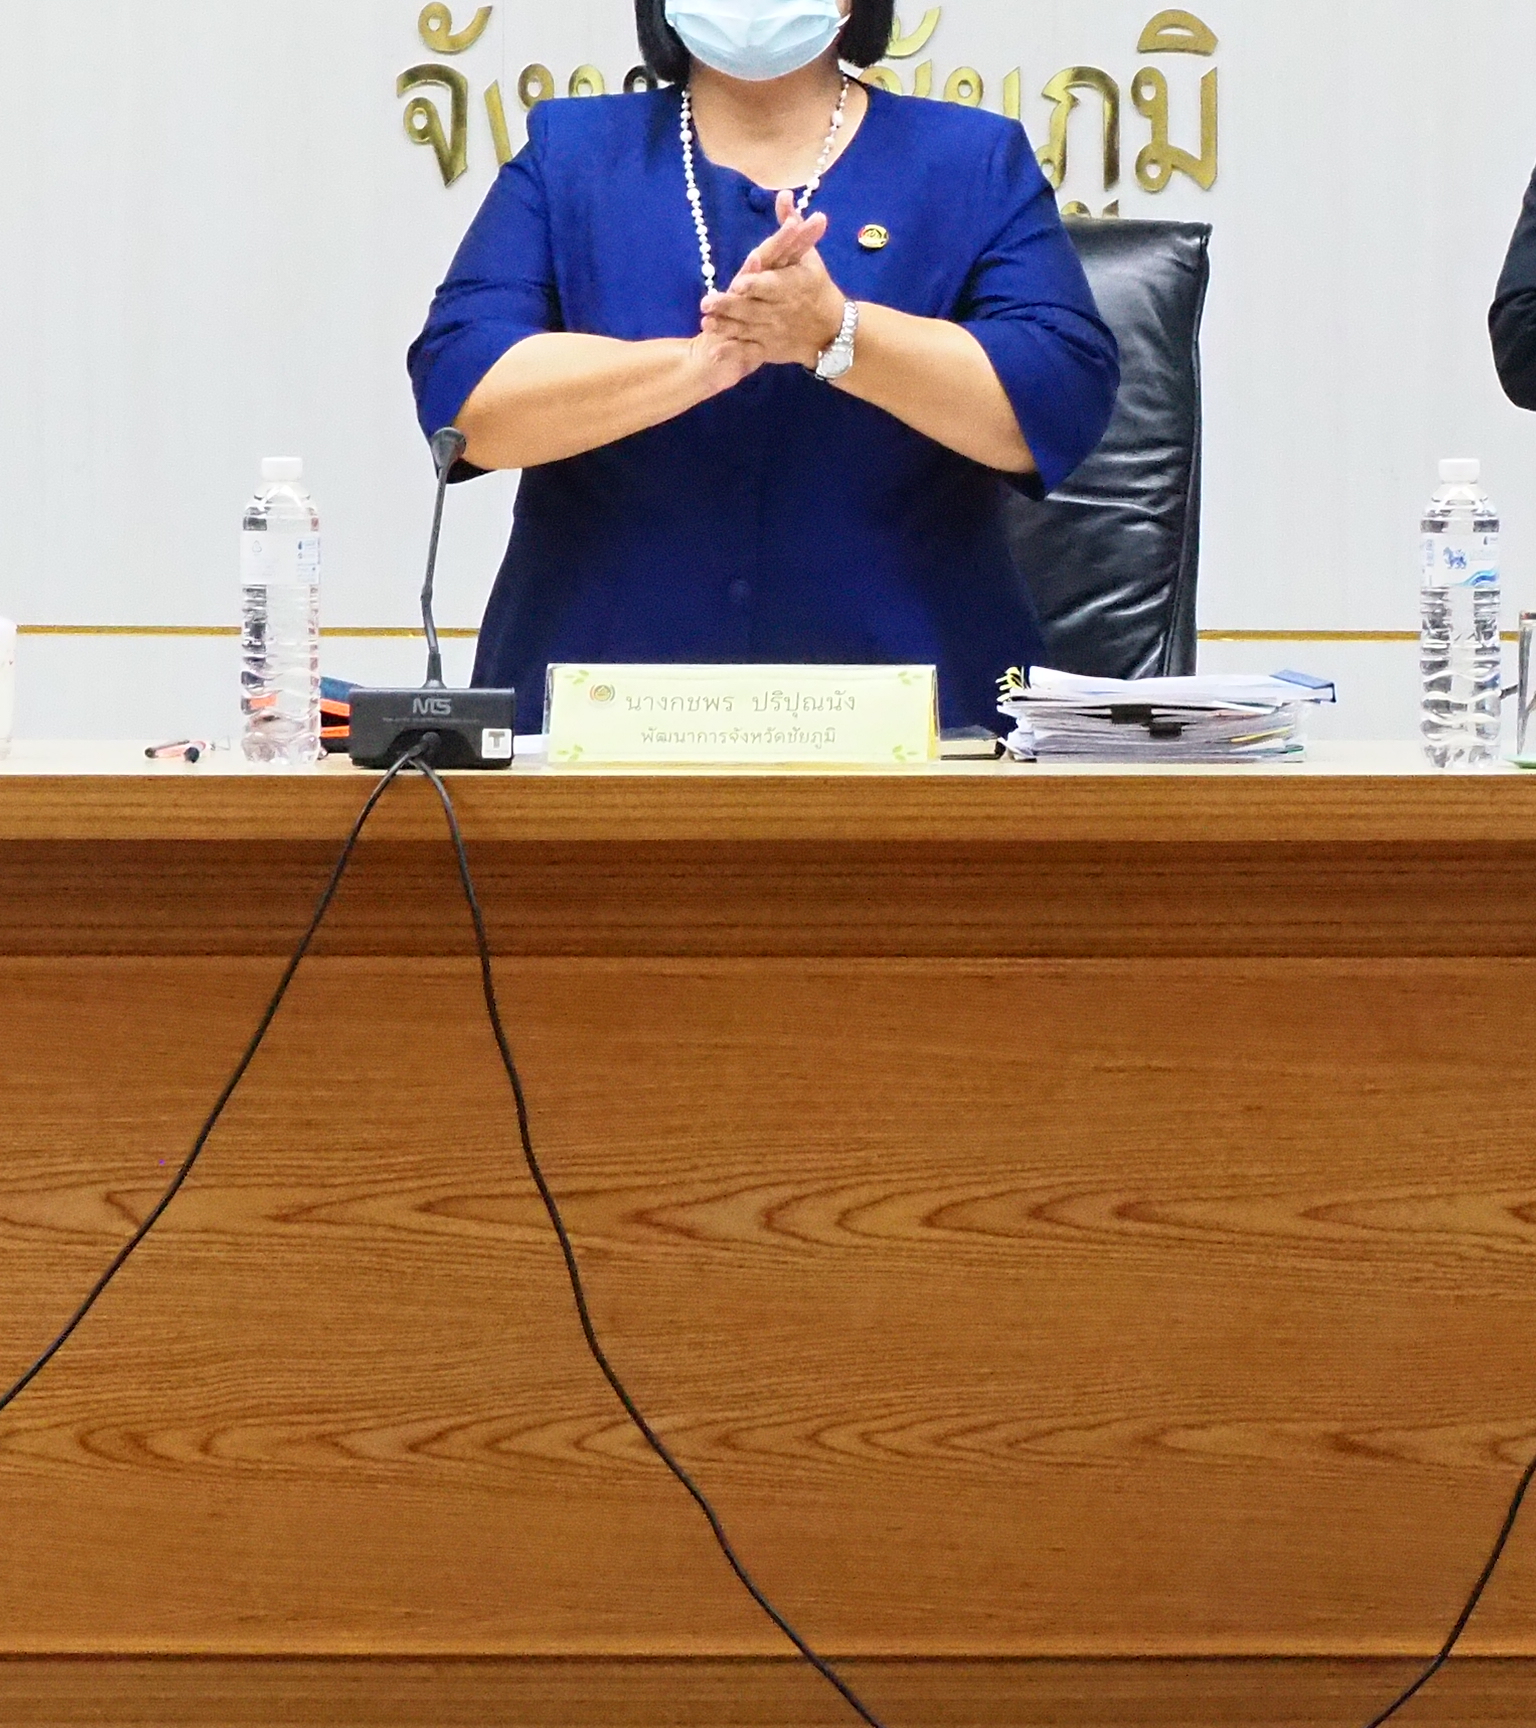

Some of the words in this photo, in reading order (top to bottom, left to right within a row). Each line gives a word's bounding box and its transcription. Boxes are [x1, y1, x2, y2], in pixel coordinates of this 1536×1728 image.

[626, 695, 735, 712] นางกชพร
[641, 726, 837, 749] พัฒนาการจังหวัดชัยภูมิ
